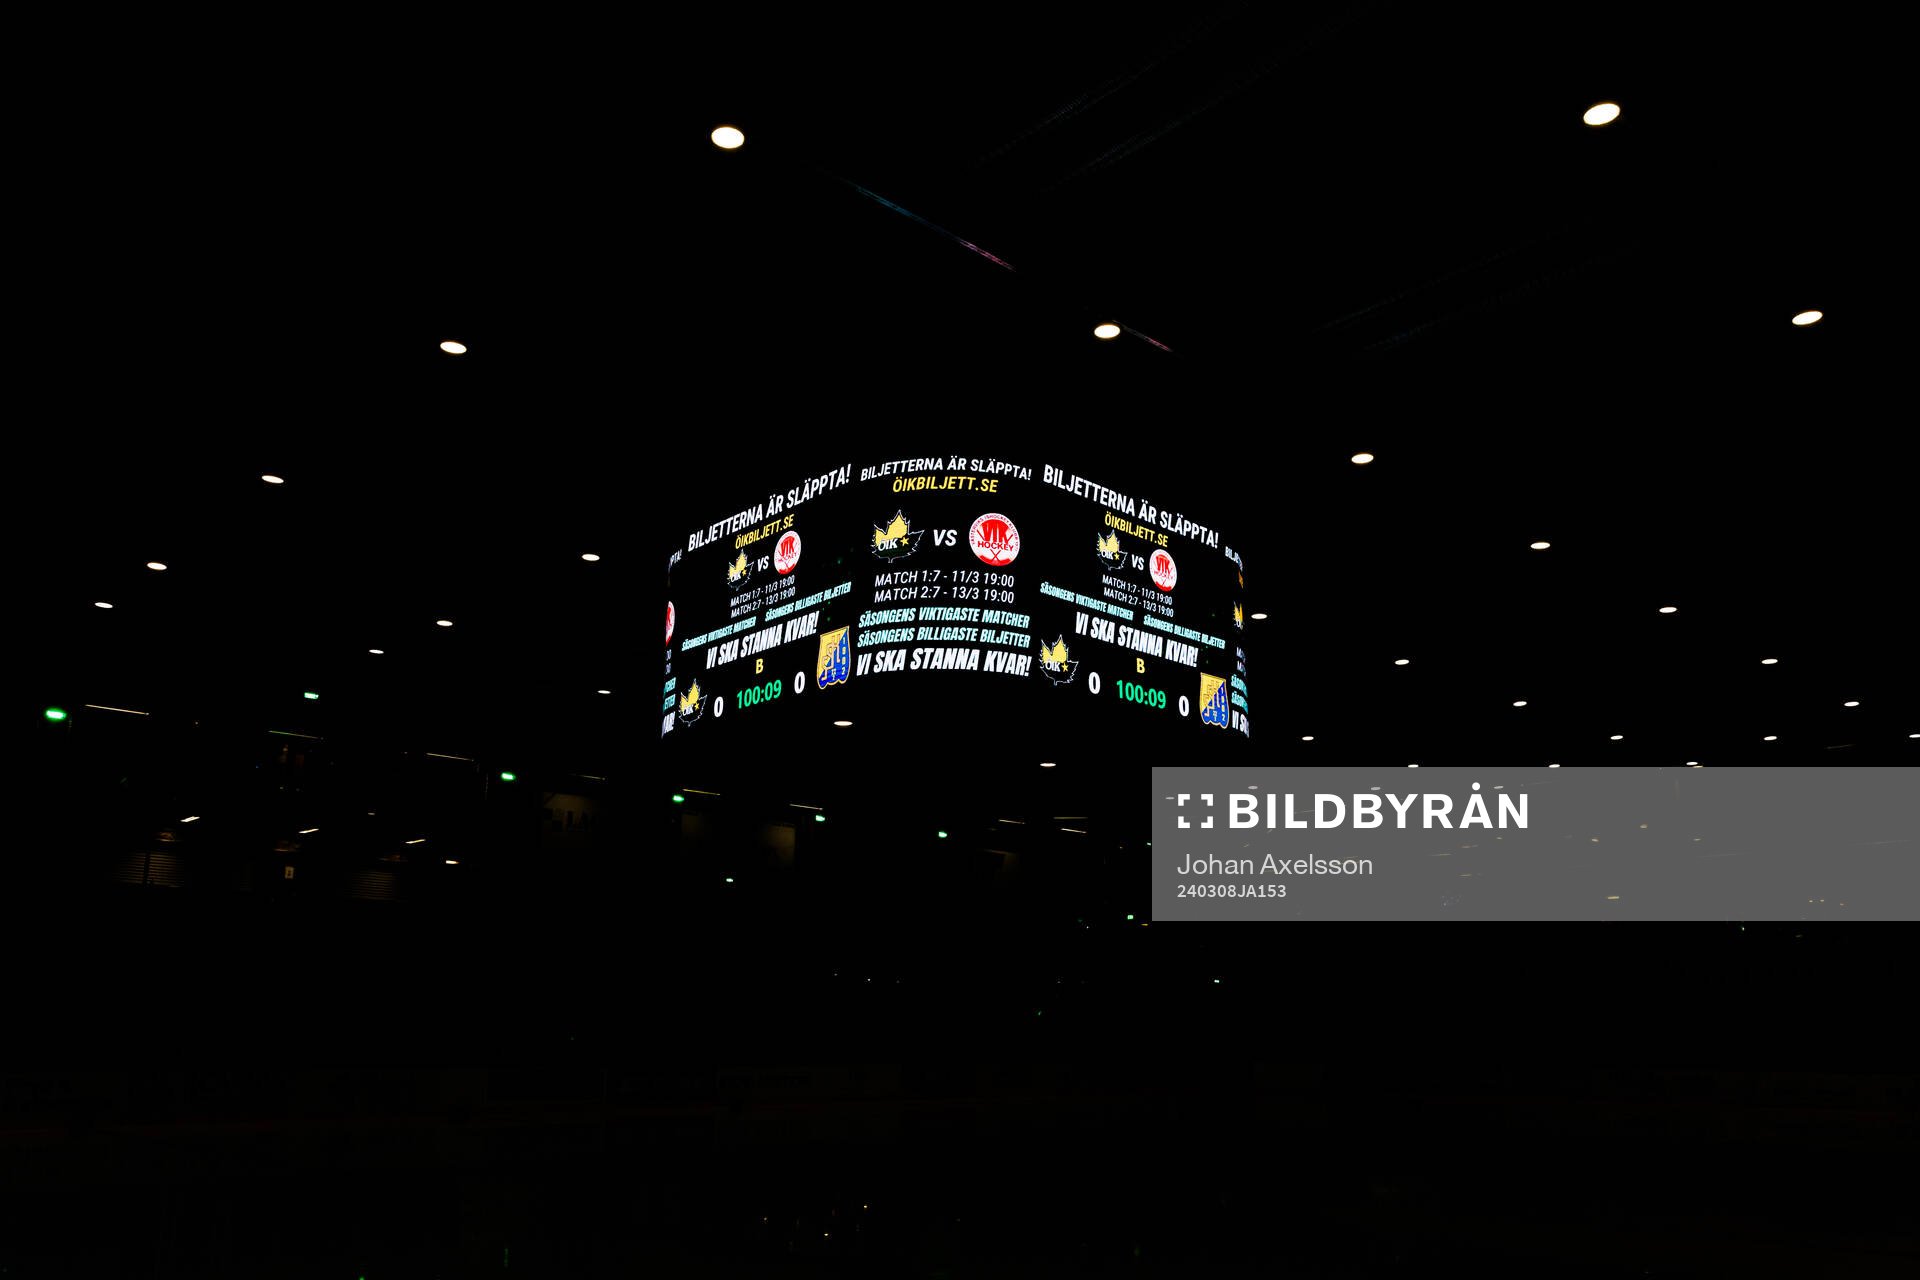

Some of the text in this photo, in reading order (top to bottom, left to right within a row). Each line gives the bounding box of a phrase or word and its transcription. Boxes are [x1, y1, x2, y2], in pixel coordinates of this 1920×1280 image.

[860, 455, 1032, 481] BILJETTERNA ÄR SLÄPPTA!
[892, 476, 998, 493] ÖIKBILJETT.SE
[688, 463, 852, 552] BILJETTERNA ÄR SLÄPPTA!
[1043, 464, 1219, 549] BILJETTERNA ÄR SLÄPPTA!
[735, 513, 795, 549] ÖIKBILJETT.SE
[933, 529, 958, 547] VS
[981, 519, 1010, 546] VIK
[1104, 511, 1169, 548] ÖIKBILJETT.SE
[878, 538, 898, 551] ÖIK
[977, 541, 1014, 552] HOCKEY
[757, 556, 770, 572] VS
[1131, 554, 1145, 571] VS
[874, 571, 918, 587] MATCH
[922, 569, 941, 583] 1:7
[952, 570, 980, 583] 11/3
[983, 572, 1015, 587] 19:00
[1102, 574, 1126, 589] MATCH
[1127, 583, 1137, 593] 1:7
[1141, 588, 1155, 600] 11/3
[1156, 592, 1173, 606] 19:00
[730, 592, 751, 607] MATCH
[752, 588, 761, 599] 1:7
[765, 581, 778, 594] 11/3
[779, 575, 796, 588] 19:00
[731, 604, 751, 618] MATCH
[752, 600, 762, 610] 2:7
[766, 593, 779, 605] 13/3
[780, 586, 796, 600] 19:00
[874, 587, 918, 603] MATCH
[920, 586, 941, 599] 2:7
[952, 586, 980, 600] 13/3
[983, 588, 1015, 604] 19:00
[1103, 587, 1127, 602] MATCH
[1128, 595, 1139, 606] 2:7
[1142, 600, 1157, 612] 13/3
[1158, 605, 1174, 618] 19:00
[858, 607, 1031, 629] SÄSONGENS VIKTIGASTE MATCHER
[706, 644, 718, 669] VI
[718, 639, 740, 665] SKA
[740, 623, 783, 658] STANNA
[784, 611, 820, 643] KVAR!
[857, 626, 1031, 649] SÄSONGENS BILLIGASTE BILJETTER
[1075, 611, 1199, 667] VI SKA STANNA KVAR!
[756, 658, 764, 674] B
[856, 652, 872, 677] VI
[873, 649, 907, 673] SKA
[910, 648, 980, 670] STANNA
[983, 651, 1033, 677] KVAR!
[1136, 657, 1145, 674] B
[737, 679, 782, 709] 100:09
[794, 671, 806, 694] 0
[1088, 671, 1101, 695] 0
[1116, 679, 1167, 709] 100:09
[713, 696, 724, 717] 0
[1178, 695, 1190, 717] 0
